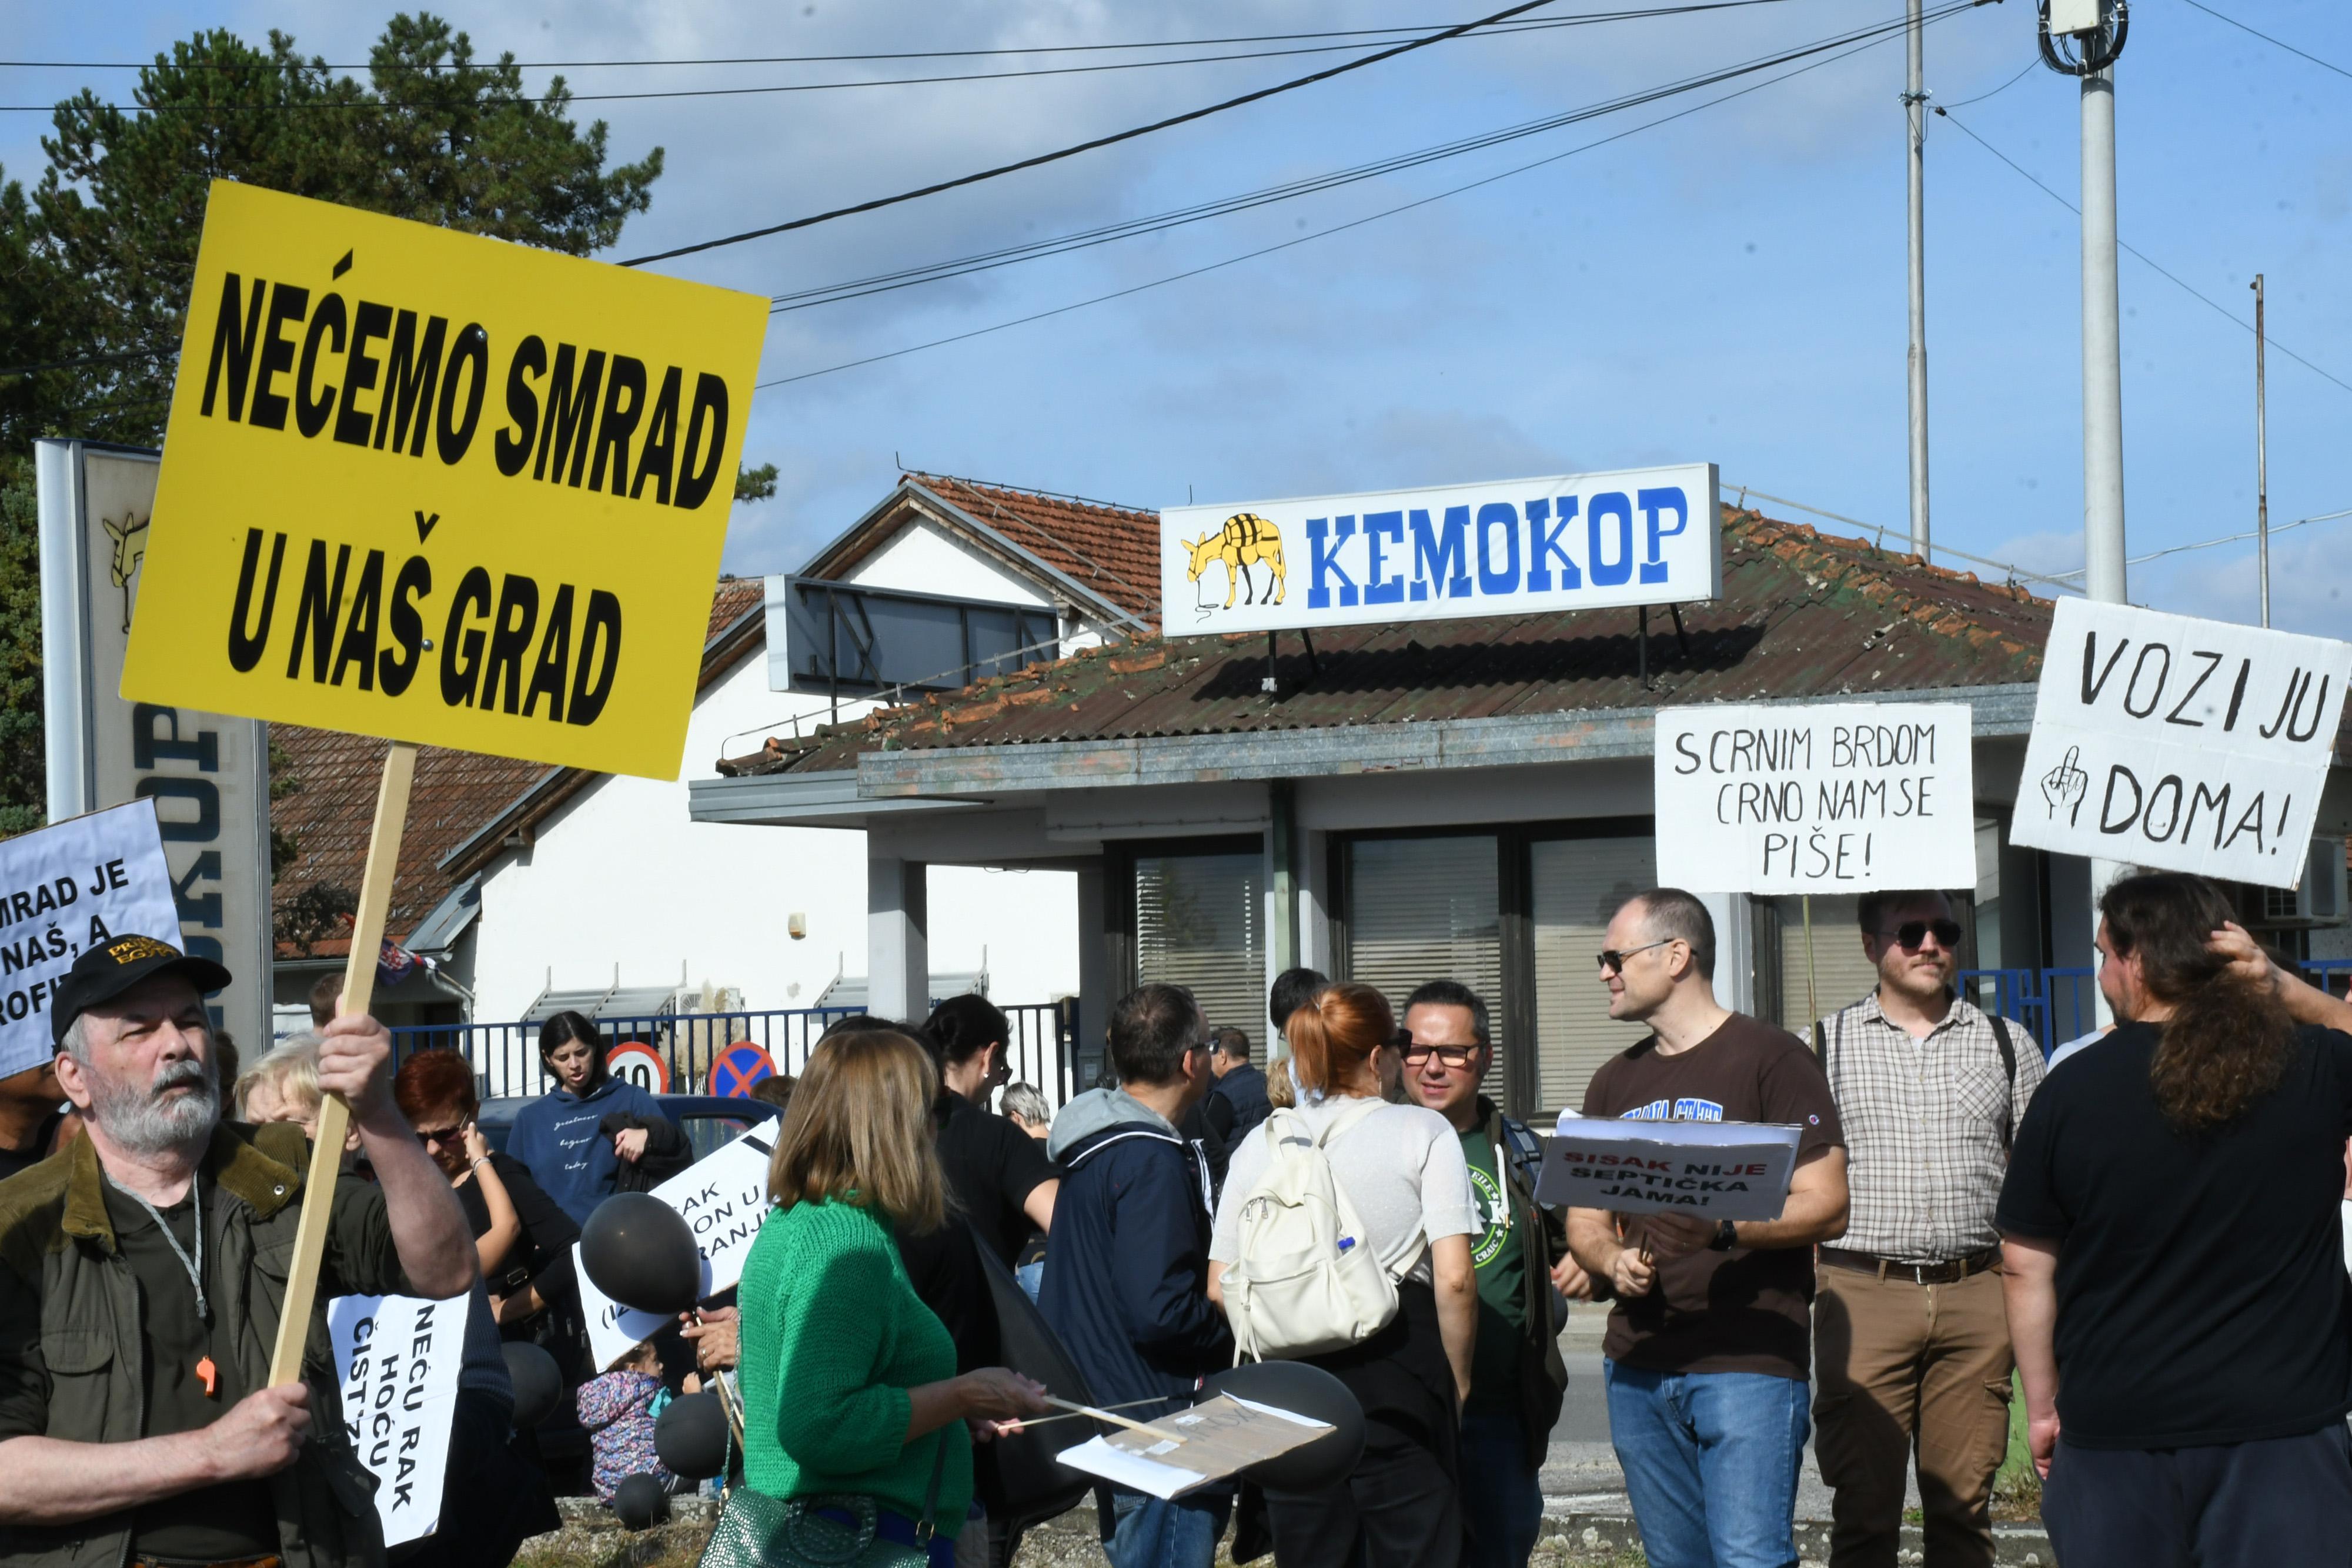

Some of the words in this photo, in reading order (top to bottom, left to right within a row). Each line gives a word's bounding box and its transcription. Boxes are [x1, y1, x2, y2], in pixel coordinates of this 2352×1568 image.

[200, 247, 488, 466] NEĆEMO
[495, 334, 729, 510] SMRAD
[1307, 486, 1689, 610] KEMOKOP
[228, 527, 288, 673] U
[286, 510, 440, 697] NAŠ
[439, 566, 622, 727] GRAD
[1675, 733, 1701, 774] S
[1709, 727, 1811, 774] CRNIM
[1832, 724, 1935, 768] BRDOM
[1717, 781, 1803, 824] CRNO
[1818, 780, 1886, 820] NAM
[1893, 776, 1935, 817] SE
[2100, 764, 2291, 855] DOMA!
[89, 858, 129, 895] JE
[1763, 825, 1872, 880] PIŠE!
[1, 921, 78, 976] NAŠ,
[89, 914, 111, 946] A
[554, 1114, 598, 1131] greatness
[560, 1137, 592, 1149] begins
[564, 1162, 589, 1170] today
[1563, 1151, 1673, 1173] SISAK
[1684, 1163, 1768, 1176] NIJE
[1570, 1166, 1749, 1192] SEPTIČKA
[674, 1181, 720, 1217] AK
[741, 1184, 759, 1206] U
[1600, 1185, 1710, 1207] JAMA!
[1475, 1239, 1499, 1263] CRAIC
[403, 1303, 436, 1412] NEĆU
[369, 1353, 399, 1467] HOĆU
[391, 1426, 421, 1514] RAK
